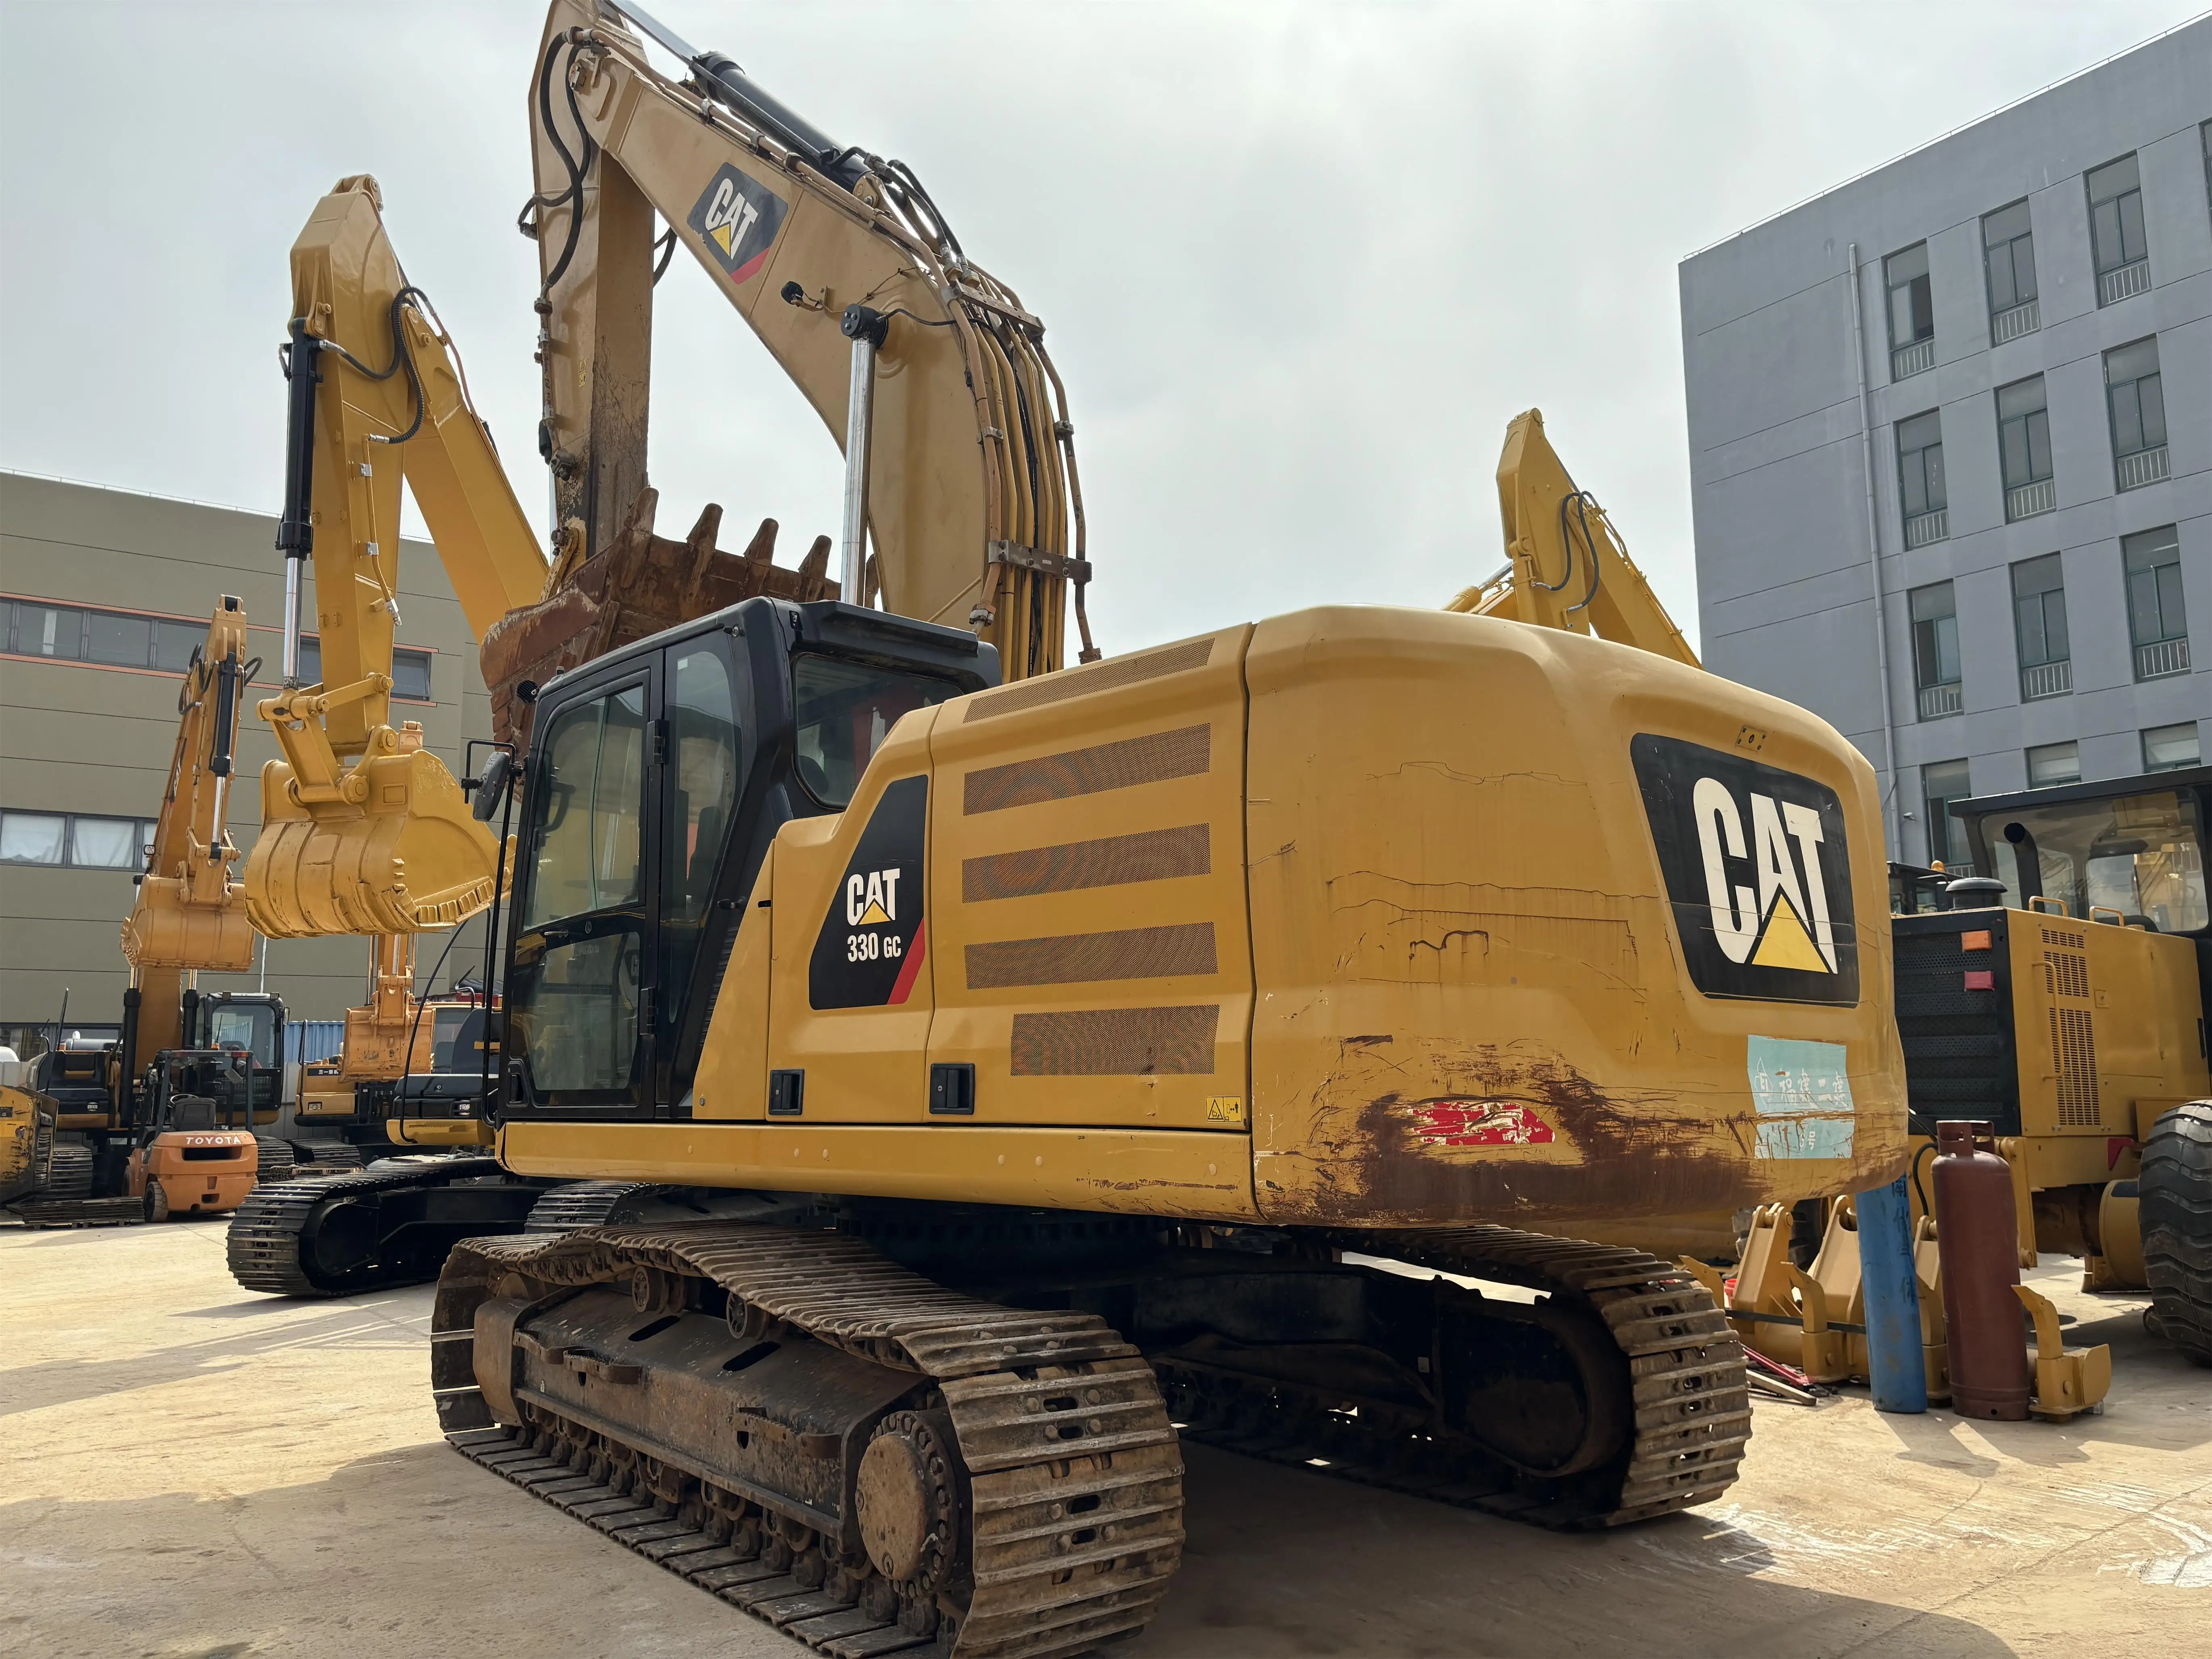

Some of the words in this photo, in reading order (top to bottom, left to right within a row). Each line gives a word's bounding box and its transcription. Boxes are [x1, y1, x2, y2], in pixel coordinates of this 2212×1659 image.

[705, 178, 758, 260] CAT
[847, 868, 900, 926] CAT
[1693, 777, 1838, 974] CAT
[847, 932, 877, 962] 330
[884, 936, 901, 958] GC
[186, 1136, 242, 1145] TOYOTA
